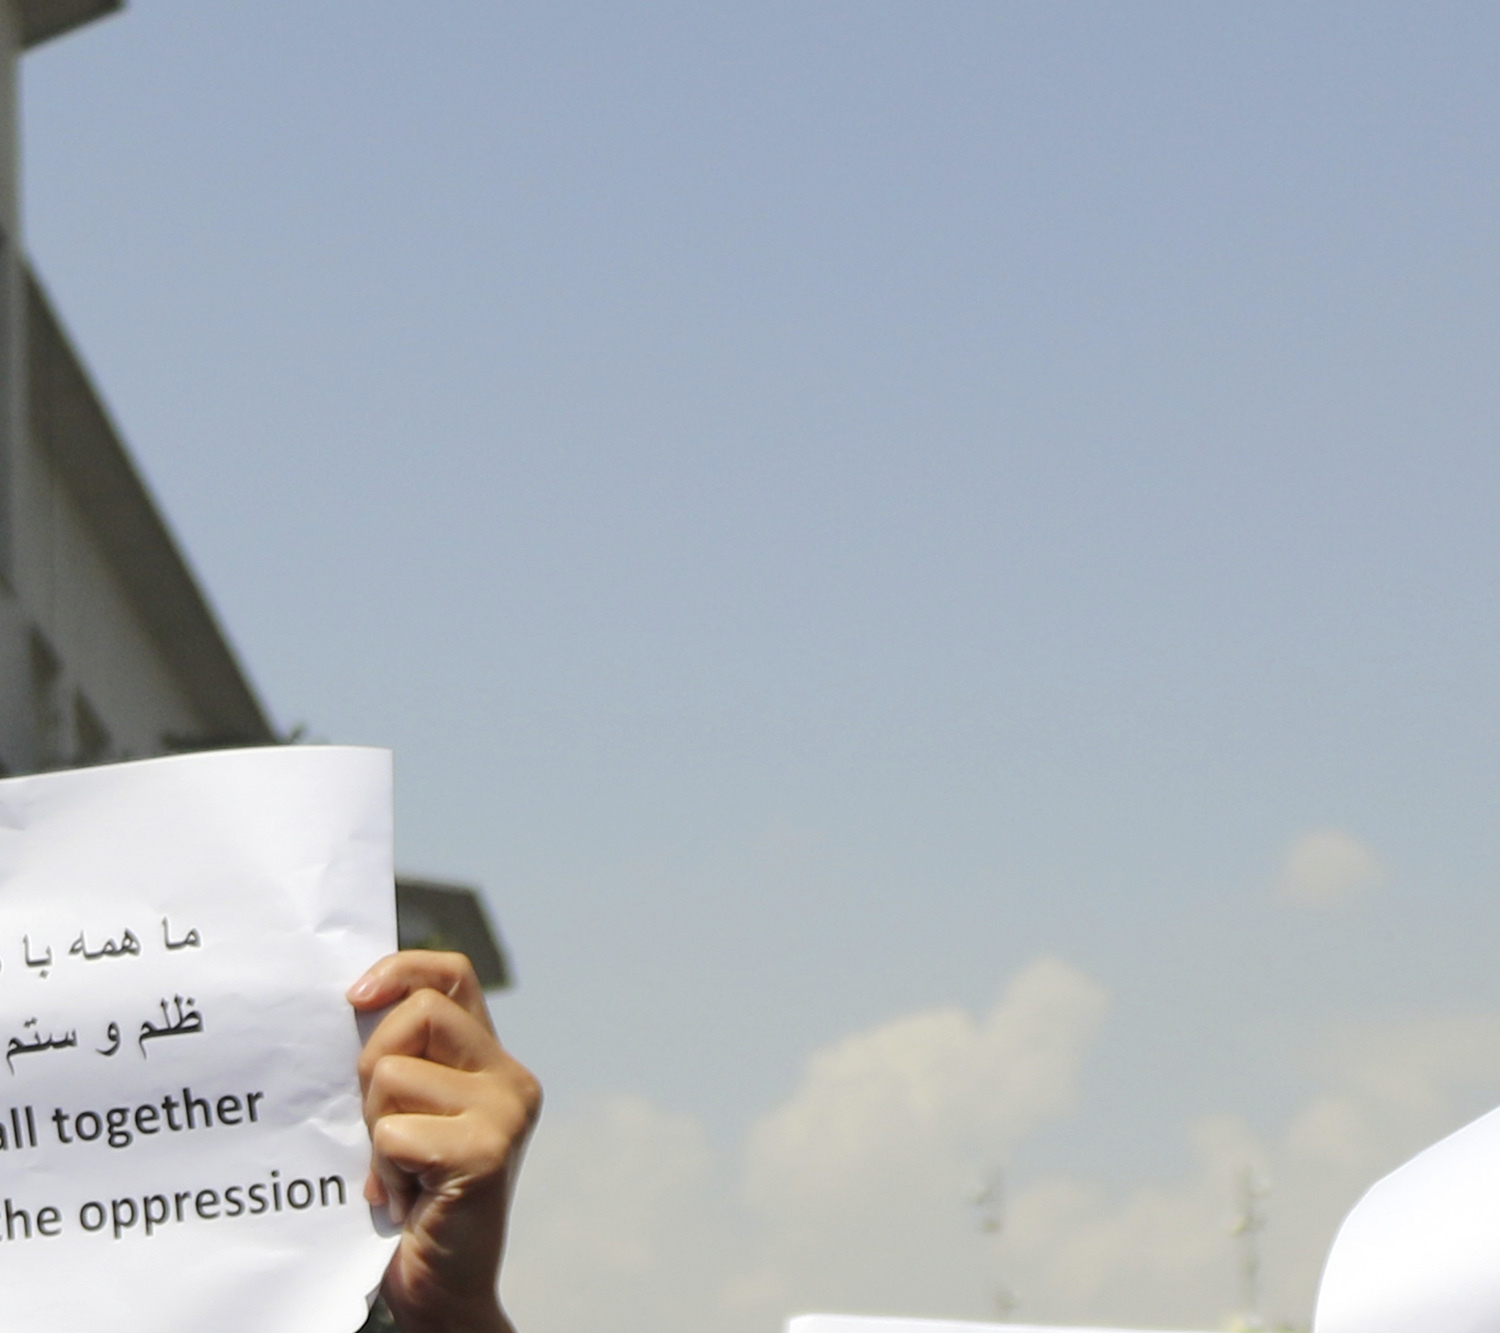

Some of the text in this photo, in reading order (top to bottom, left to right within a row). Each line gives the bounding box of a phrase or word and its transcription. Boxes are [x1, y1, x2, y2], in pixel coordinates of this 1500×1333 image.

[23, 935, 52, 978] با
[69, 929, 140, 960] همه
[162, 918, 200, 950] ما
[6, 1019, 77, 1073] ستم
[96, 1022, 120, 1056] و
[139, 996, 202, 1058] ظلم
[52, 1087, 263, 1148] together
[79, 1170, 345, 1238] oppression
